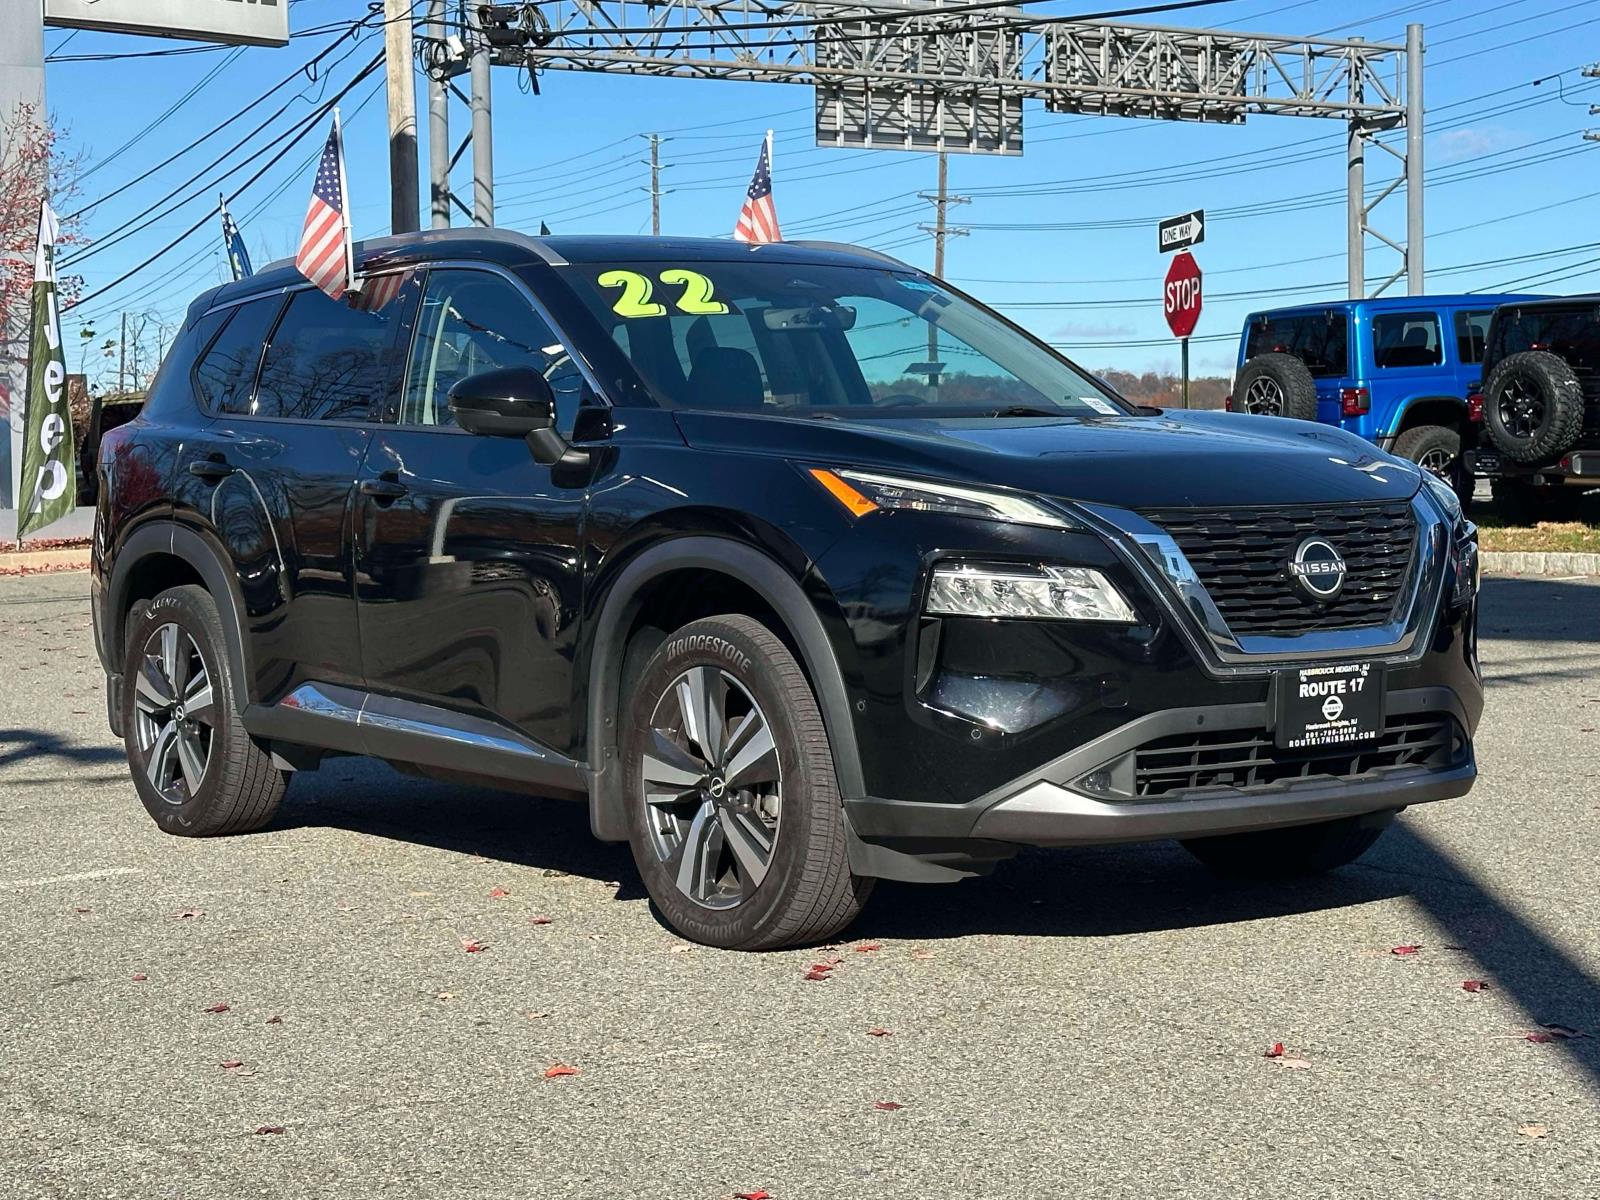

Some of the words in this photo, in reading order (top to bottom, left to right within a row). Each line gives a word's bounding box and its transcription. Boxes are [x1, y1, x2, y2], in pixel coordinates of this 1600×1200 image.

[1163, 229, 1177, 243] ONE
[1179, 223, 1193, 239] WAY
[597, 269, 730, 319] 22
[1166, 277, 1200, 313] STOP
[30, 292, 68, 514] Jeep
[1293, 561, 1347, 574] NISSAN
[667, 635, 752, 673] BRIDGESTONE
[1299, 680, 1346, 698] ROUTE
[1349, 677, 1365, 692] 17
[1288, 731, 1375, 747] ROUTE17NISSAN.COM
